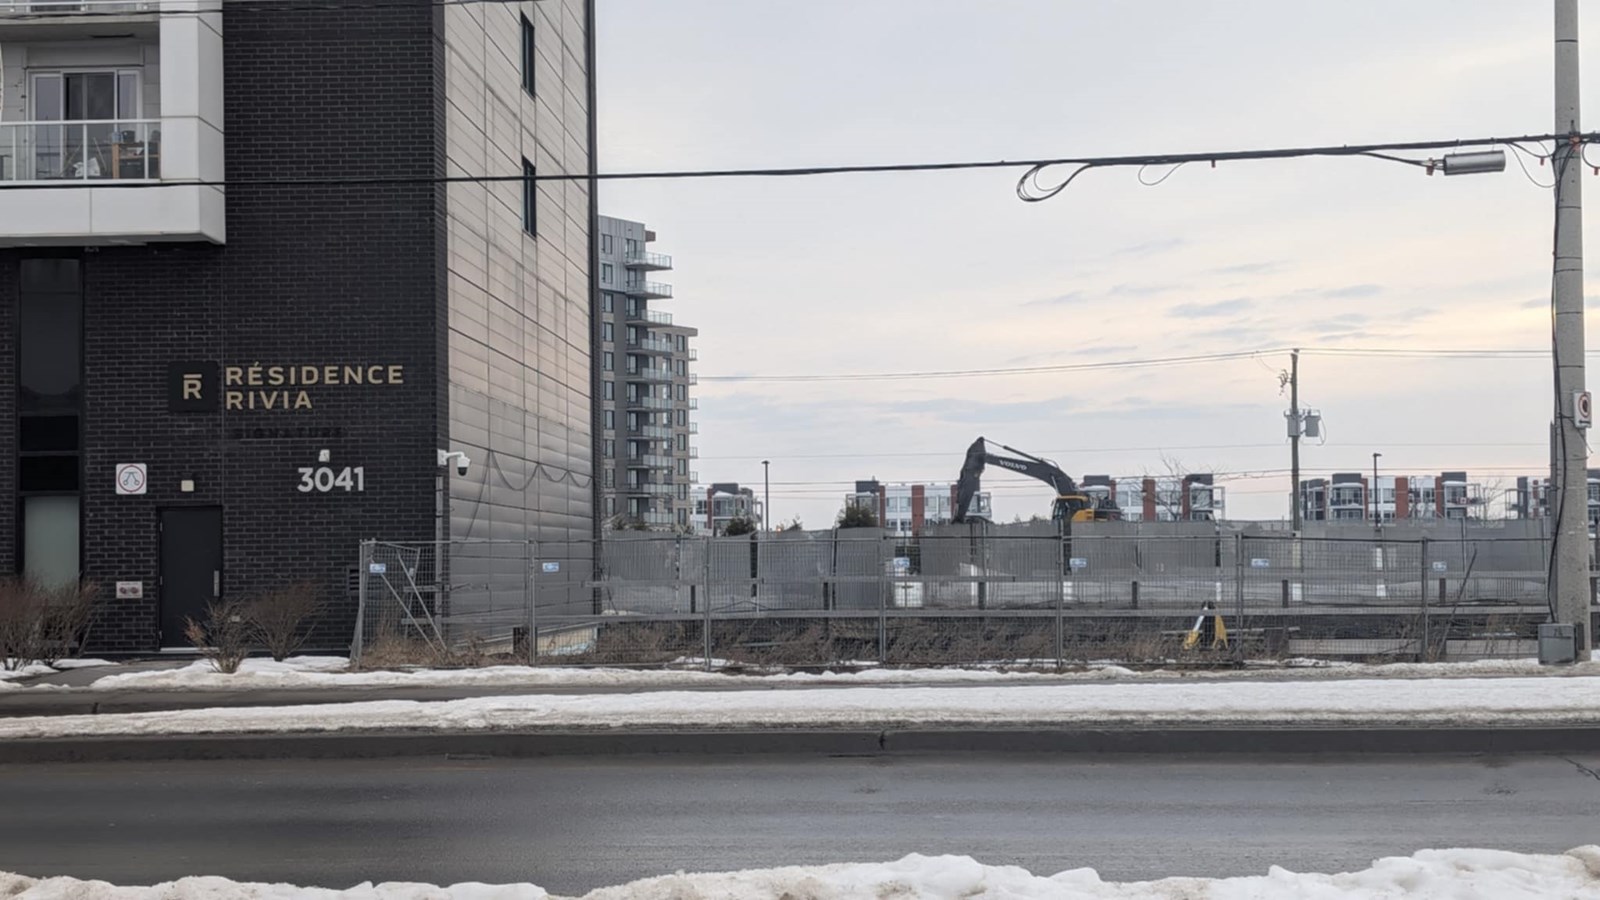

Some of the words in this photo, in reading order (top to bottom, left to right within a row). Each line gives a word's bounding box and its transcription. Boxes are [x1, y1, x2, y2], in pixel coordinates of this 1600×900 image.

[226, 361, 404, 386] RÉSIDENCE
[226, 390, 312, 410] RIVIA
[998, 459, 1027, 471] VOLVO
[297, 466, 364, 492] 3041
